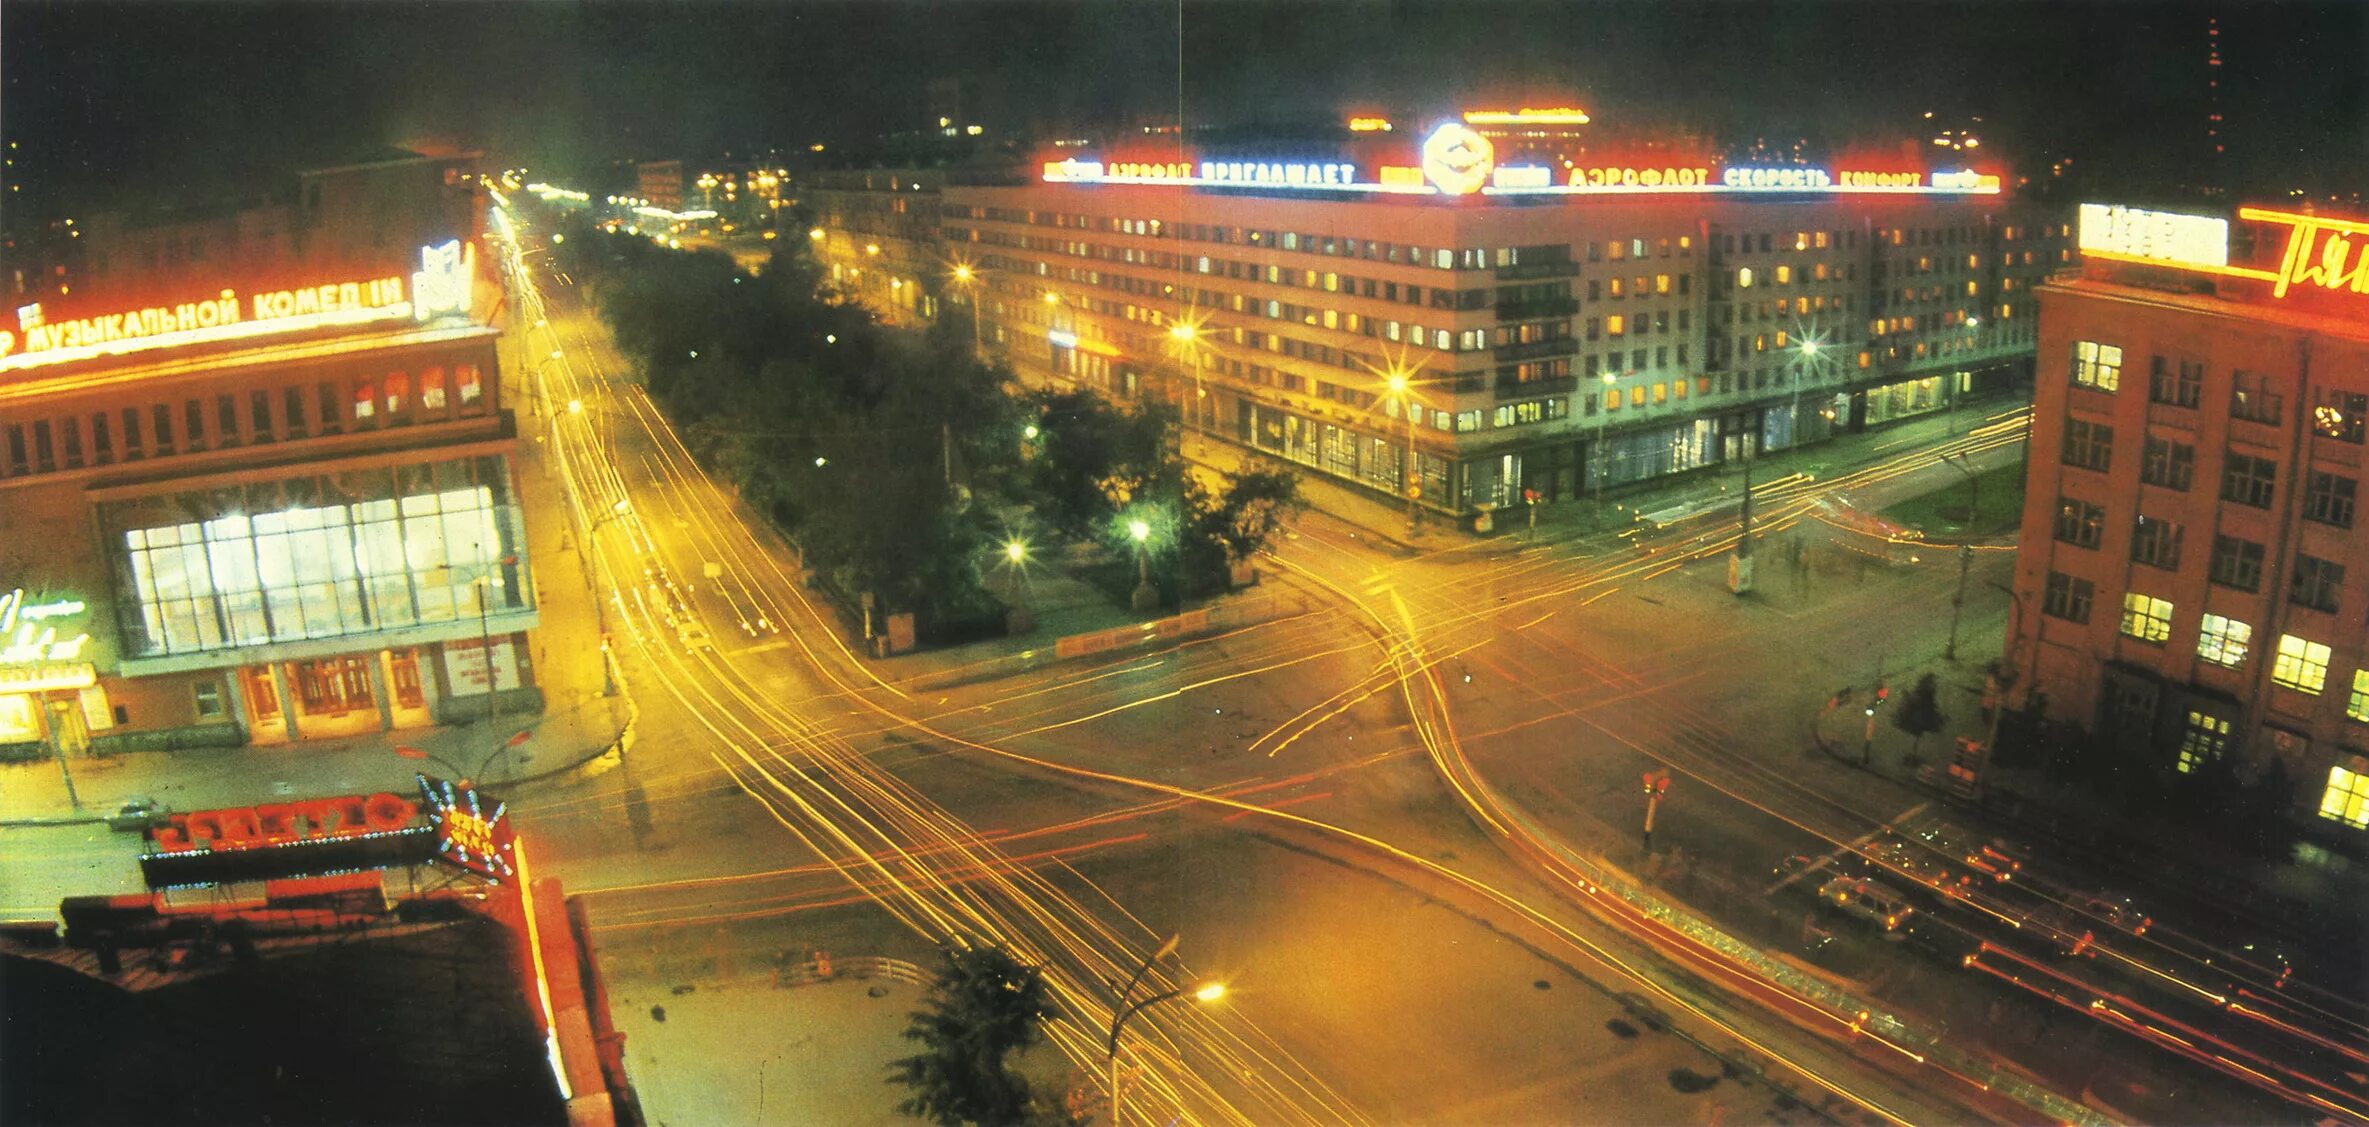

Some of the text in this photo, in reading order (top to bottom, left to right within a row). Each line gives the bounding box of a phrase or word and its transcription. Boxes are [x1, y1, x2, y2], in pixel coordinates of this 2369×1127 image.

[1202, 162, 1355, 184] ПРИГЛАШАЕТ
[1568, 168, 1921, 186] АЭРОФЛОТ СКОРОСТЬ КОМФОРТ
[26, 288, 240, 353] МУЗЫКАЛЬНОЙ
